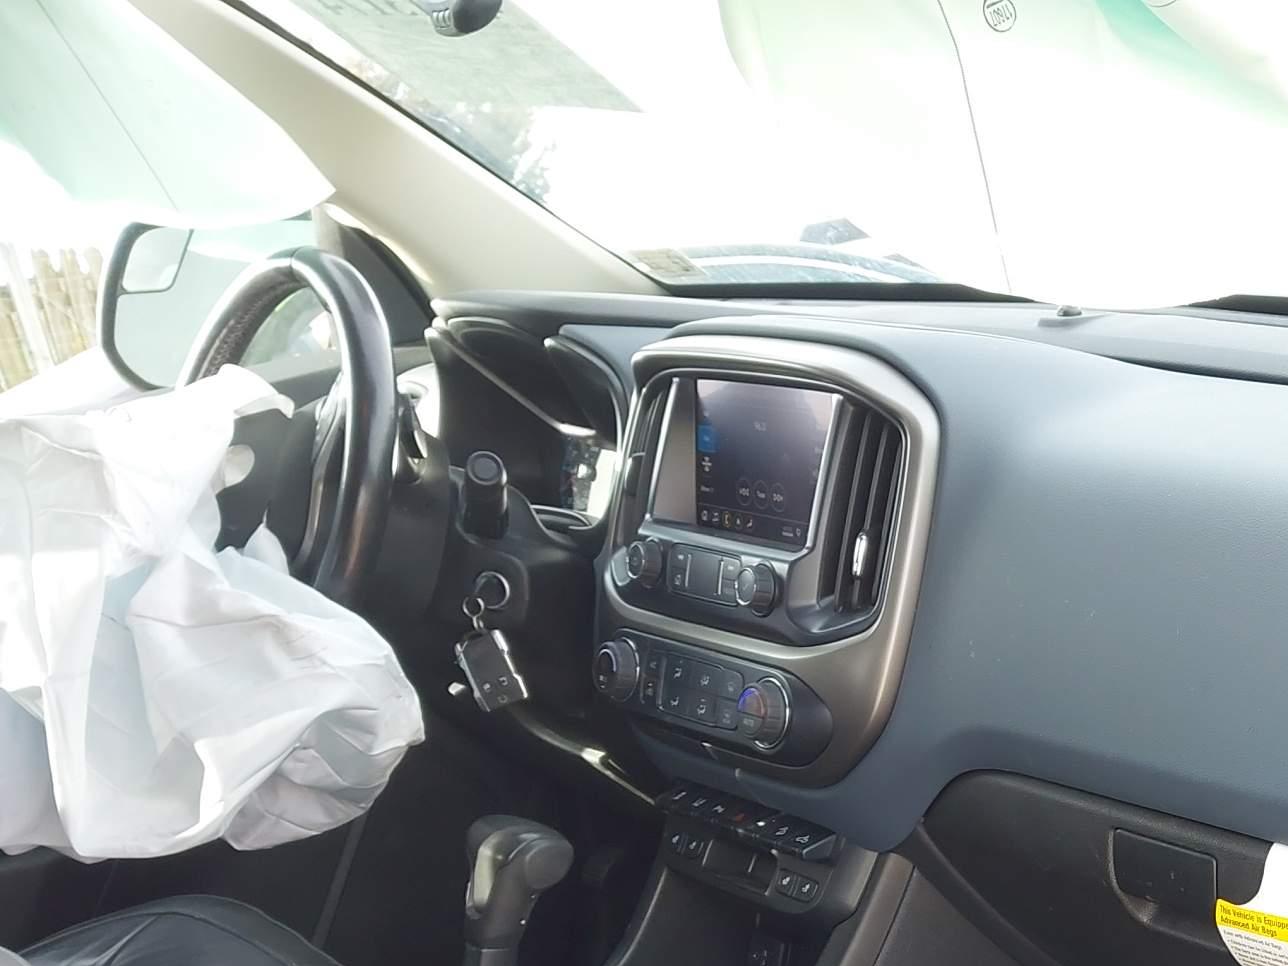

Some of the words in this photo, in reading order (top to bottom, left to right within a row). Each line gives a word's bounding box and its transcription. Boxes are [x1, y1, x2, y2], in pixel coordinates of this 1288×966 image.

[1220, 904, 1232, 916] This
[1232, 909, 1256, 922] Vehicle
[1220, 915, 1250, 930] Advanced
[1251, 922, 1260, 932] Air
[1261, 925, 1278, 938] Bags
